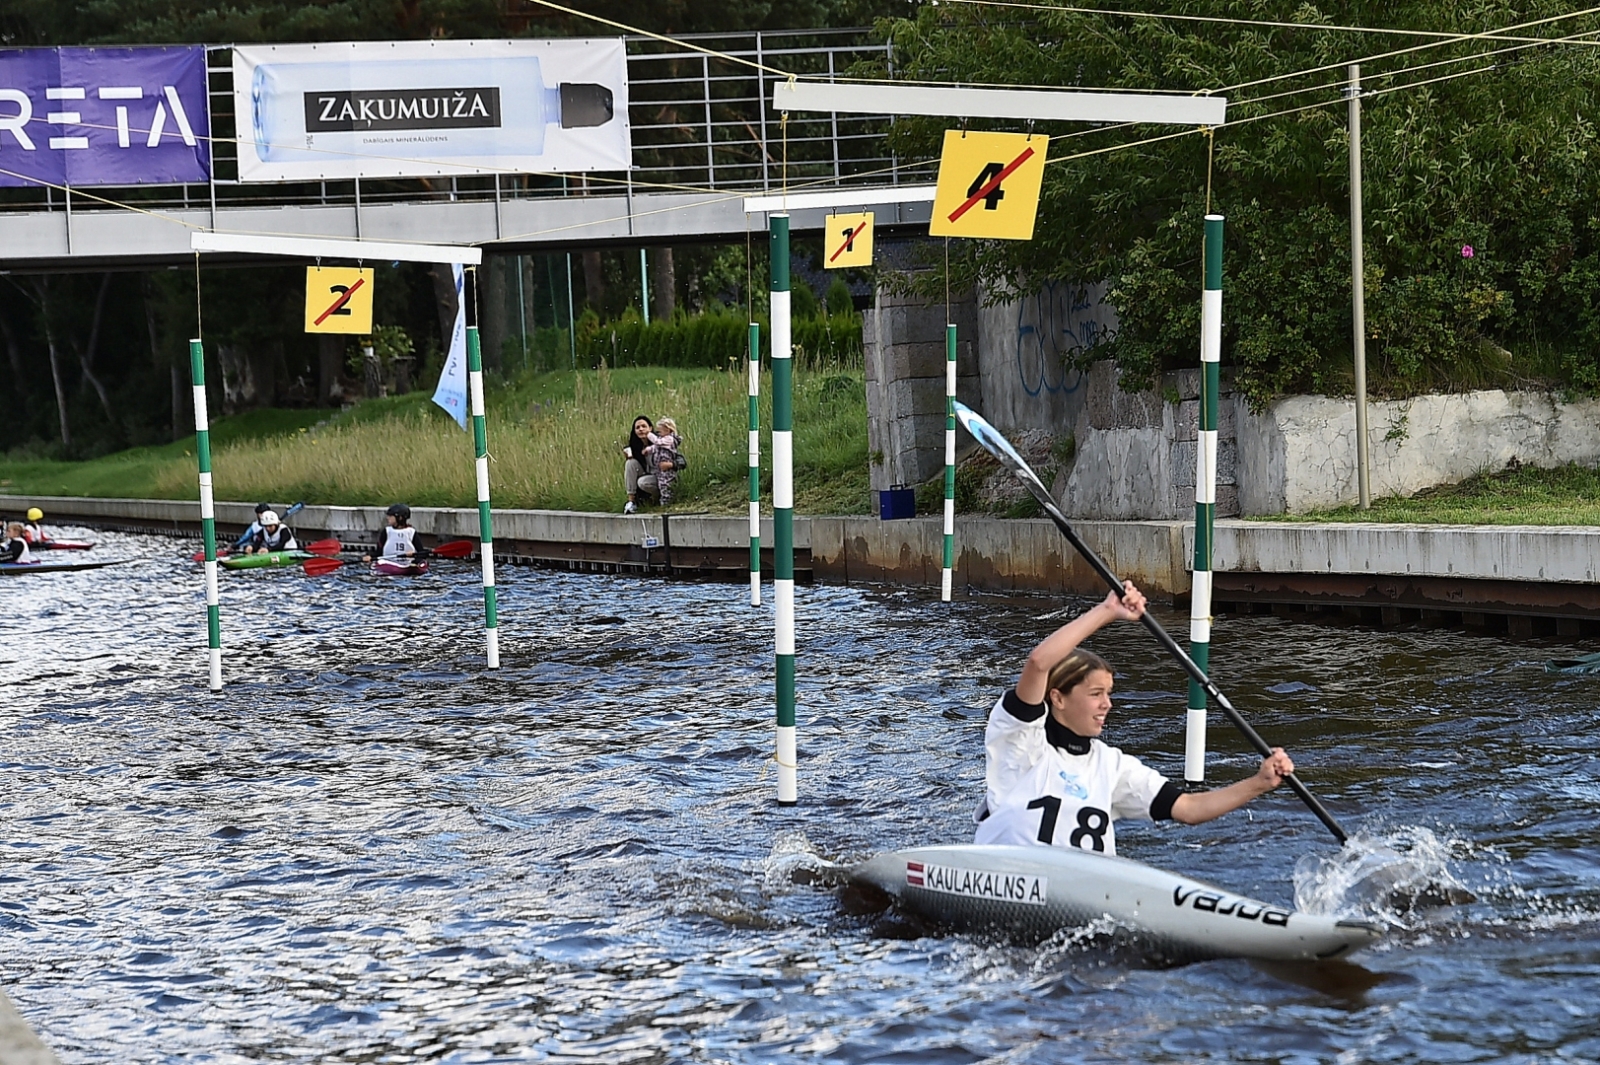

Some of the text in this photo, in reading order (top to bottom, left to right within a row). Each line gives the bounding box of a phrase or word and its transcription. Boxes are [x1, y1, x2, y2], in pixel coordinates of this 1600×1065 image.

[318, 90, 490, 127] ZAĶUMUIŽA
[966, 162, 1005, 211] 4
[841, 227, 854, 252] 1
[329, 285, 352, 316] 2
[1026, 795, 1110, 853] 18
[926, 865, 1045, 902] KAULAKALNS A.
